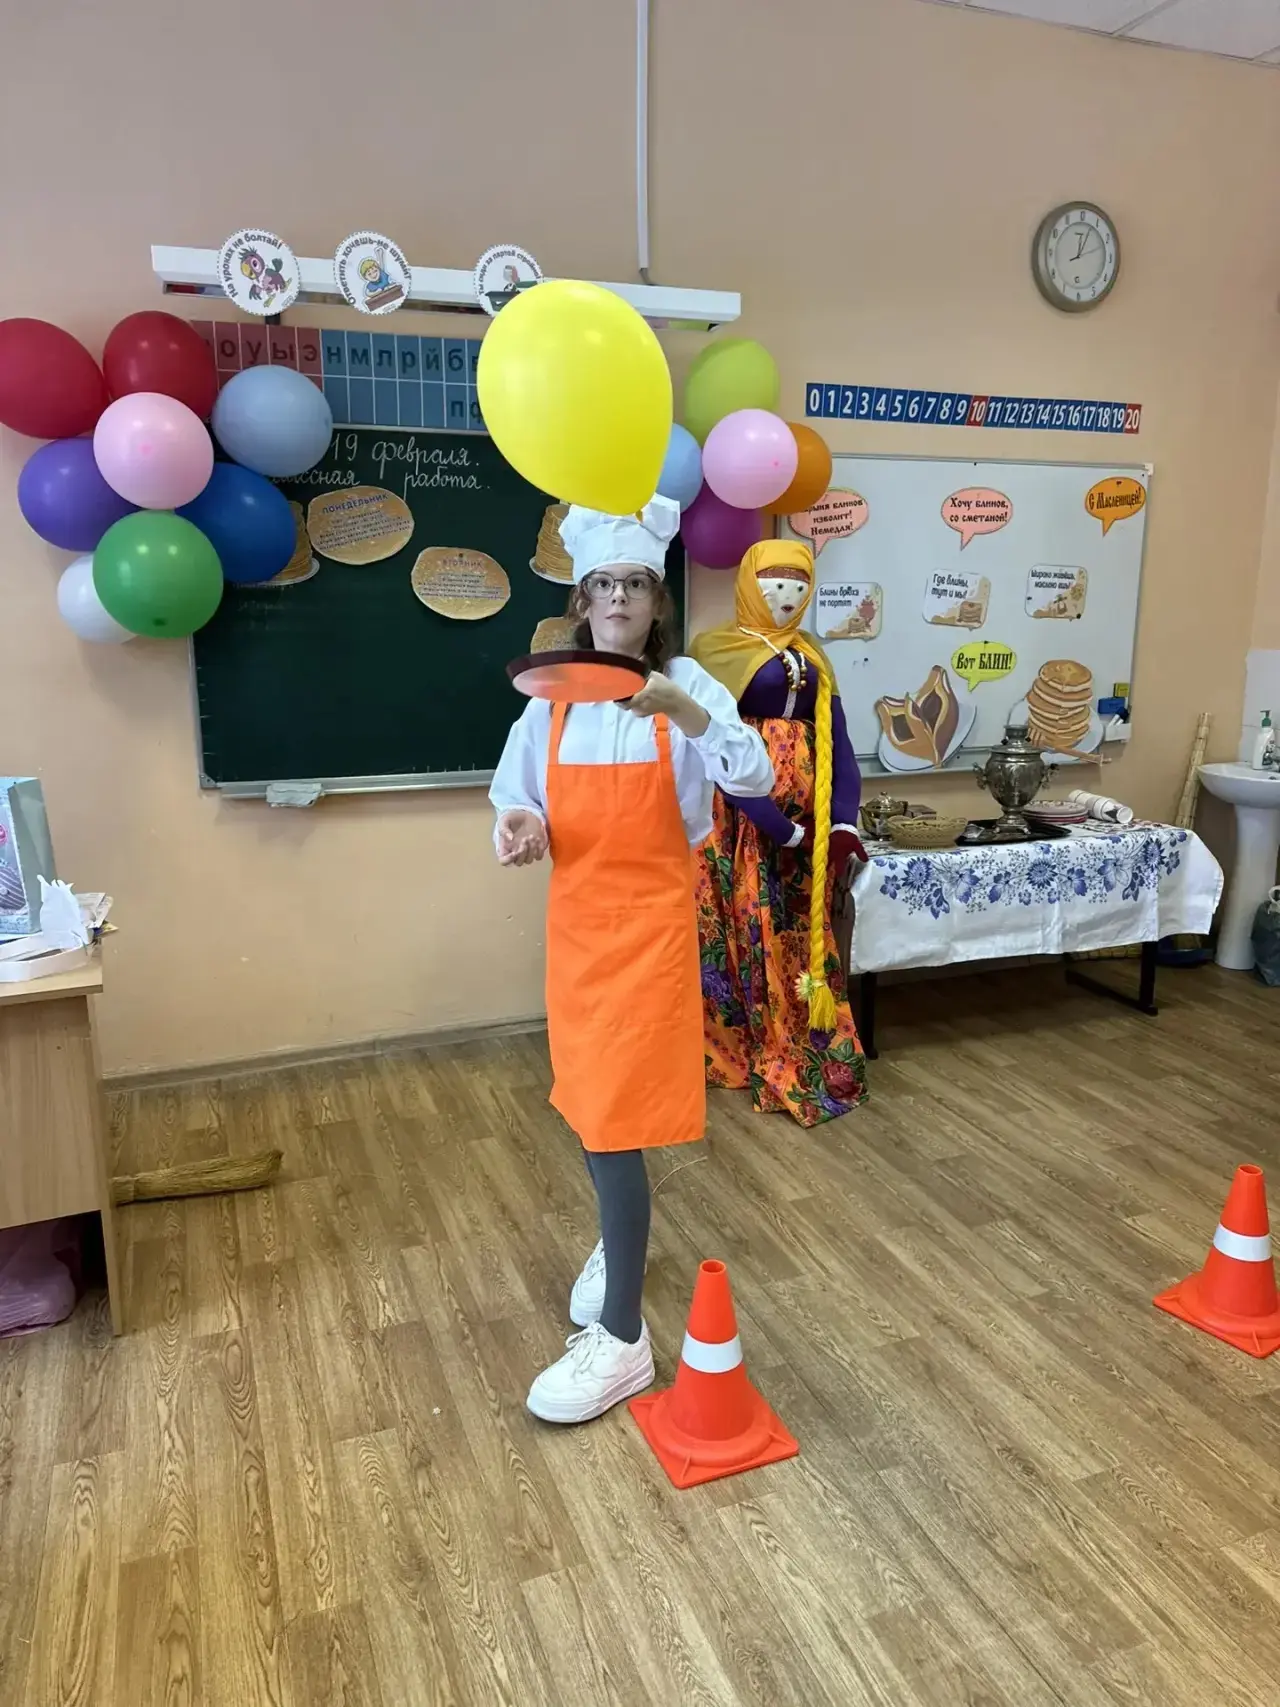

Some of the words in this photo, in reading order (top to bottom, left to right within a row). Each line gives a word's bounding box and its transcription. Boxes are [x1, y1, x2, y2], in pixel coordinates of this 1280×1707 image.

[222, 248, 236, 282] уроках
[232, 238, 244, 249] не
[244, 232, 282, 250] болтай!
[339, 260, 356, 304] Ответить
[810, 389, 819, 411] 0
[828, 390, 834, 412] 1
[843, 391, 853, 414] 2
[860, 392, 869, 415] 3
[876, 394, 886, 416] 4
[892, 395, 903, 417] 5
[909, 396, 919, 418] 6
[924, 398, 936, 418] 7
[940, 399, 951, 420] 8
[956, 400, 967, 420] 9
[971, 401, 985, 422] 10
[988, 402, 1001, 422] 11
[1004, 403, 1018, 423] 12
[1020, 404, 1034, 424] 13
[1036, 404, 1050, 424] 14
[1052, 405, 1066, 425] 15
[1068, 405, 1081, 426] 16
[1082, 406, 1096, 426] 17
[1098, 407, 1110, 427] 18
[1112, 408, 1125, 428] 19
[1125, 409, 1139, 429] 20
[331, 433, 358, 461] 19
[272, 469, 360, 486] ссная
[322, 493, 388, 514] ПОНЕДЕЛЬНИК
[950, 497, 972, 511] Хочу
[976, 500, 1008, 509] блинов,
[1088, 493, 1094, 510] С
[1096, 486, 1142, 509] Масленицей!
[805, 504, 830, 514] рыня
[832, 500, 864, 509] блинов
[813, 509, 852, 524] изволит!
[950, 514, 959, 522] со
[962, 512, 1008, 522] сметаной!
[810, 521, 854, 536] Немедля!
[933, 574, 946, 586] Где
[820, 587, 838, 596] Блины
[956, 652, 976, 670] Вот
[978, 652, 1012, 670] БЛИН!
